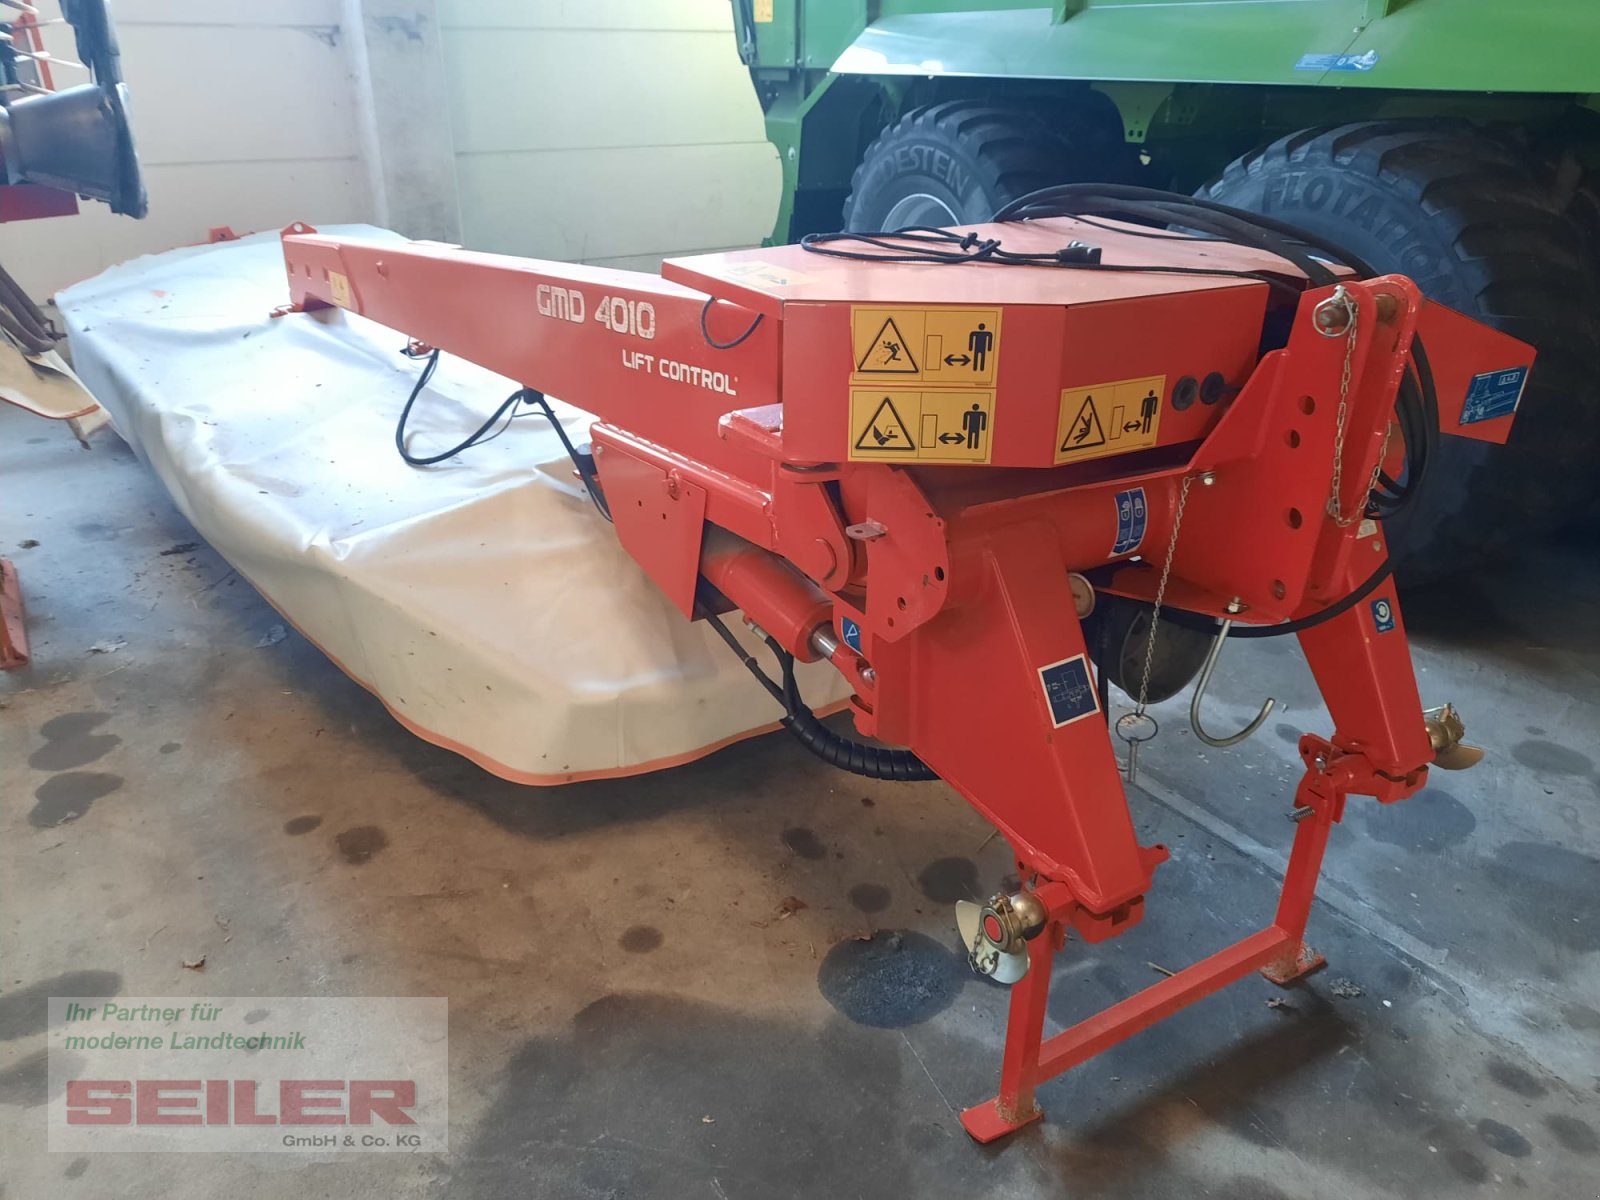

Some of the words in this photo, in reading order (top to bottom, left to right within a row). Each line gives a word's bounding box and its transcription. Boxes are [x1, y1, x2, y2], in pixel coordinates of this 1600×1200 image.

[879, 143, 970, 198] DESTEIN
[536, 283, 586, 324] GMD
[594, 295, 656, 340] 4010
[622, 348, 655, 374] LIFT
[659, 358, 738, 396] CONTROL
